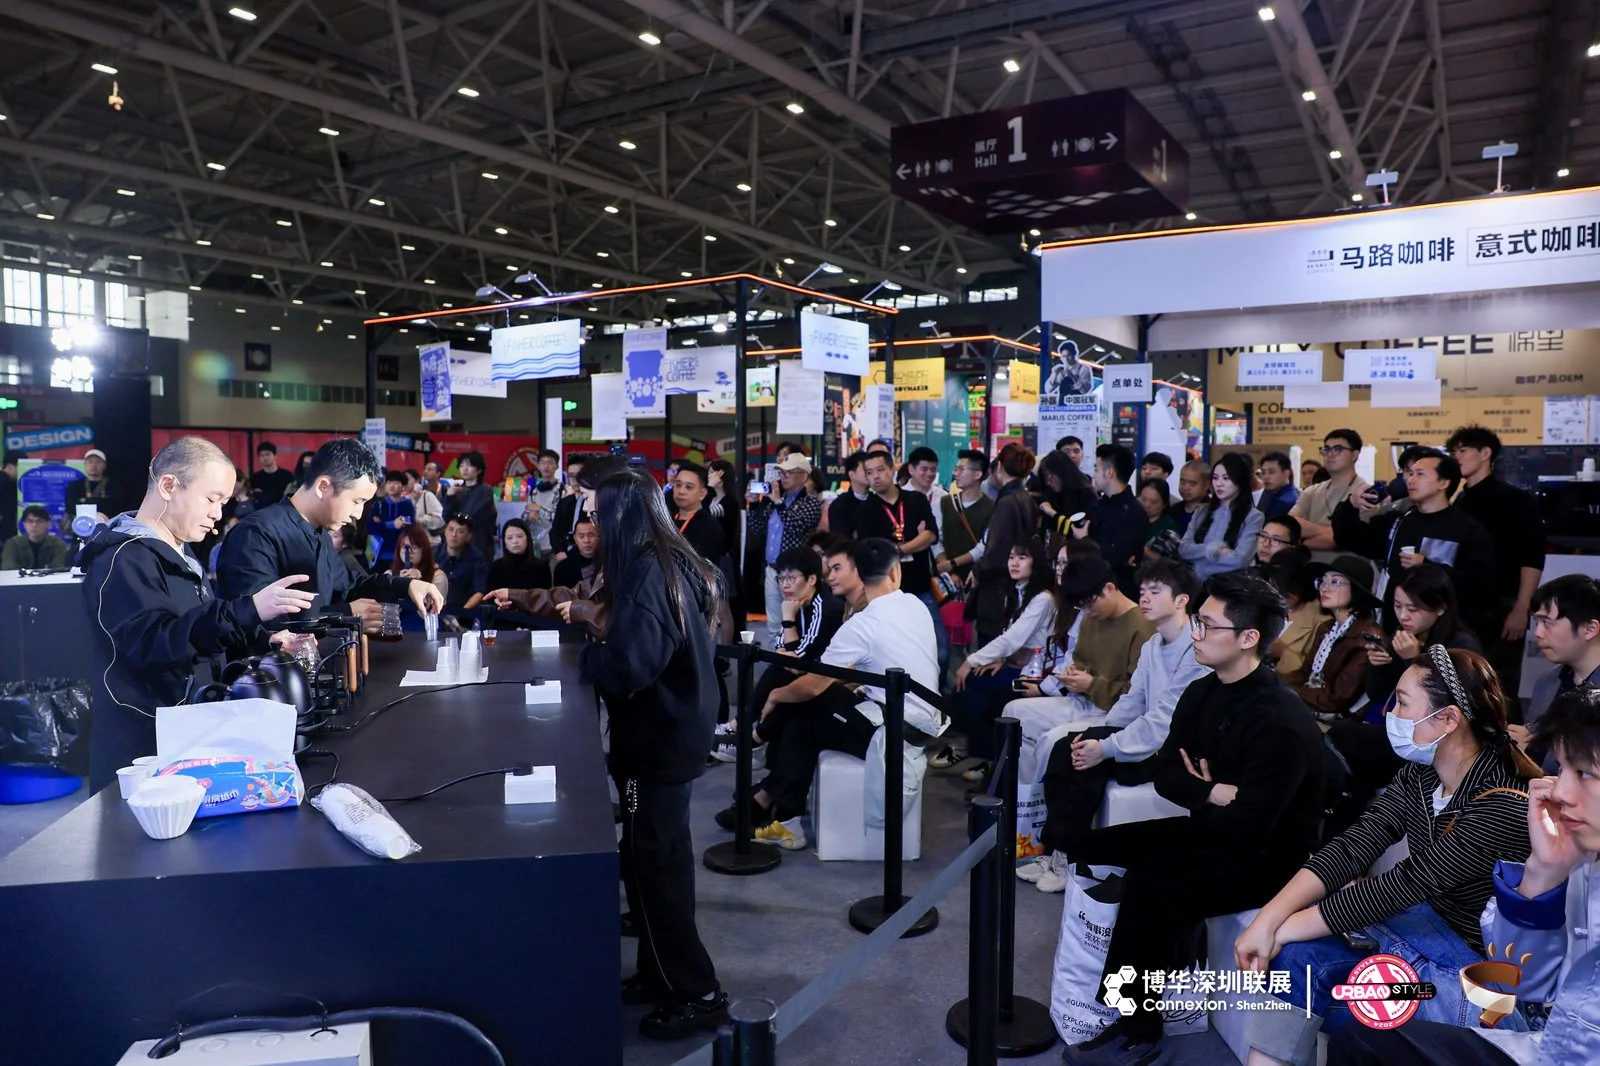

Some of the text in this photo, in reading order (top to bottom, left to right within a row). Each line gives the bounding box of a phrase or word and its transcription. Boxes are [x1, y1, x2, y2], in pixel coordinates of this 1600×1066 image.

[975, 138, 998, 153] 展厅
[1007, 115, 1028, 163] 1
[975, 153, 998, 168] Hall
[1475, 222, 1600, 259] 意式咖啡
[1340, 237, 1455, 270] 马路咖啡
[1111, 377, 1144, 389] 点单处
[1067, 413, 1094, 421] COFFEE
[7, 428, 92, 450] DESIGN
[1061, 1022, 1070, 1030] OF
[1062, 1013, 1093, 1030] EXPLORE
